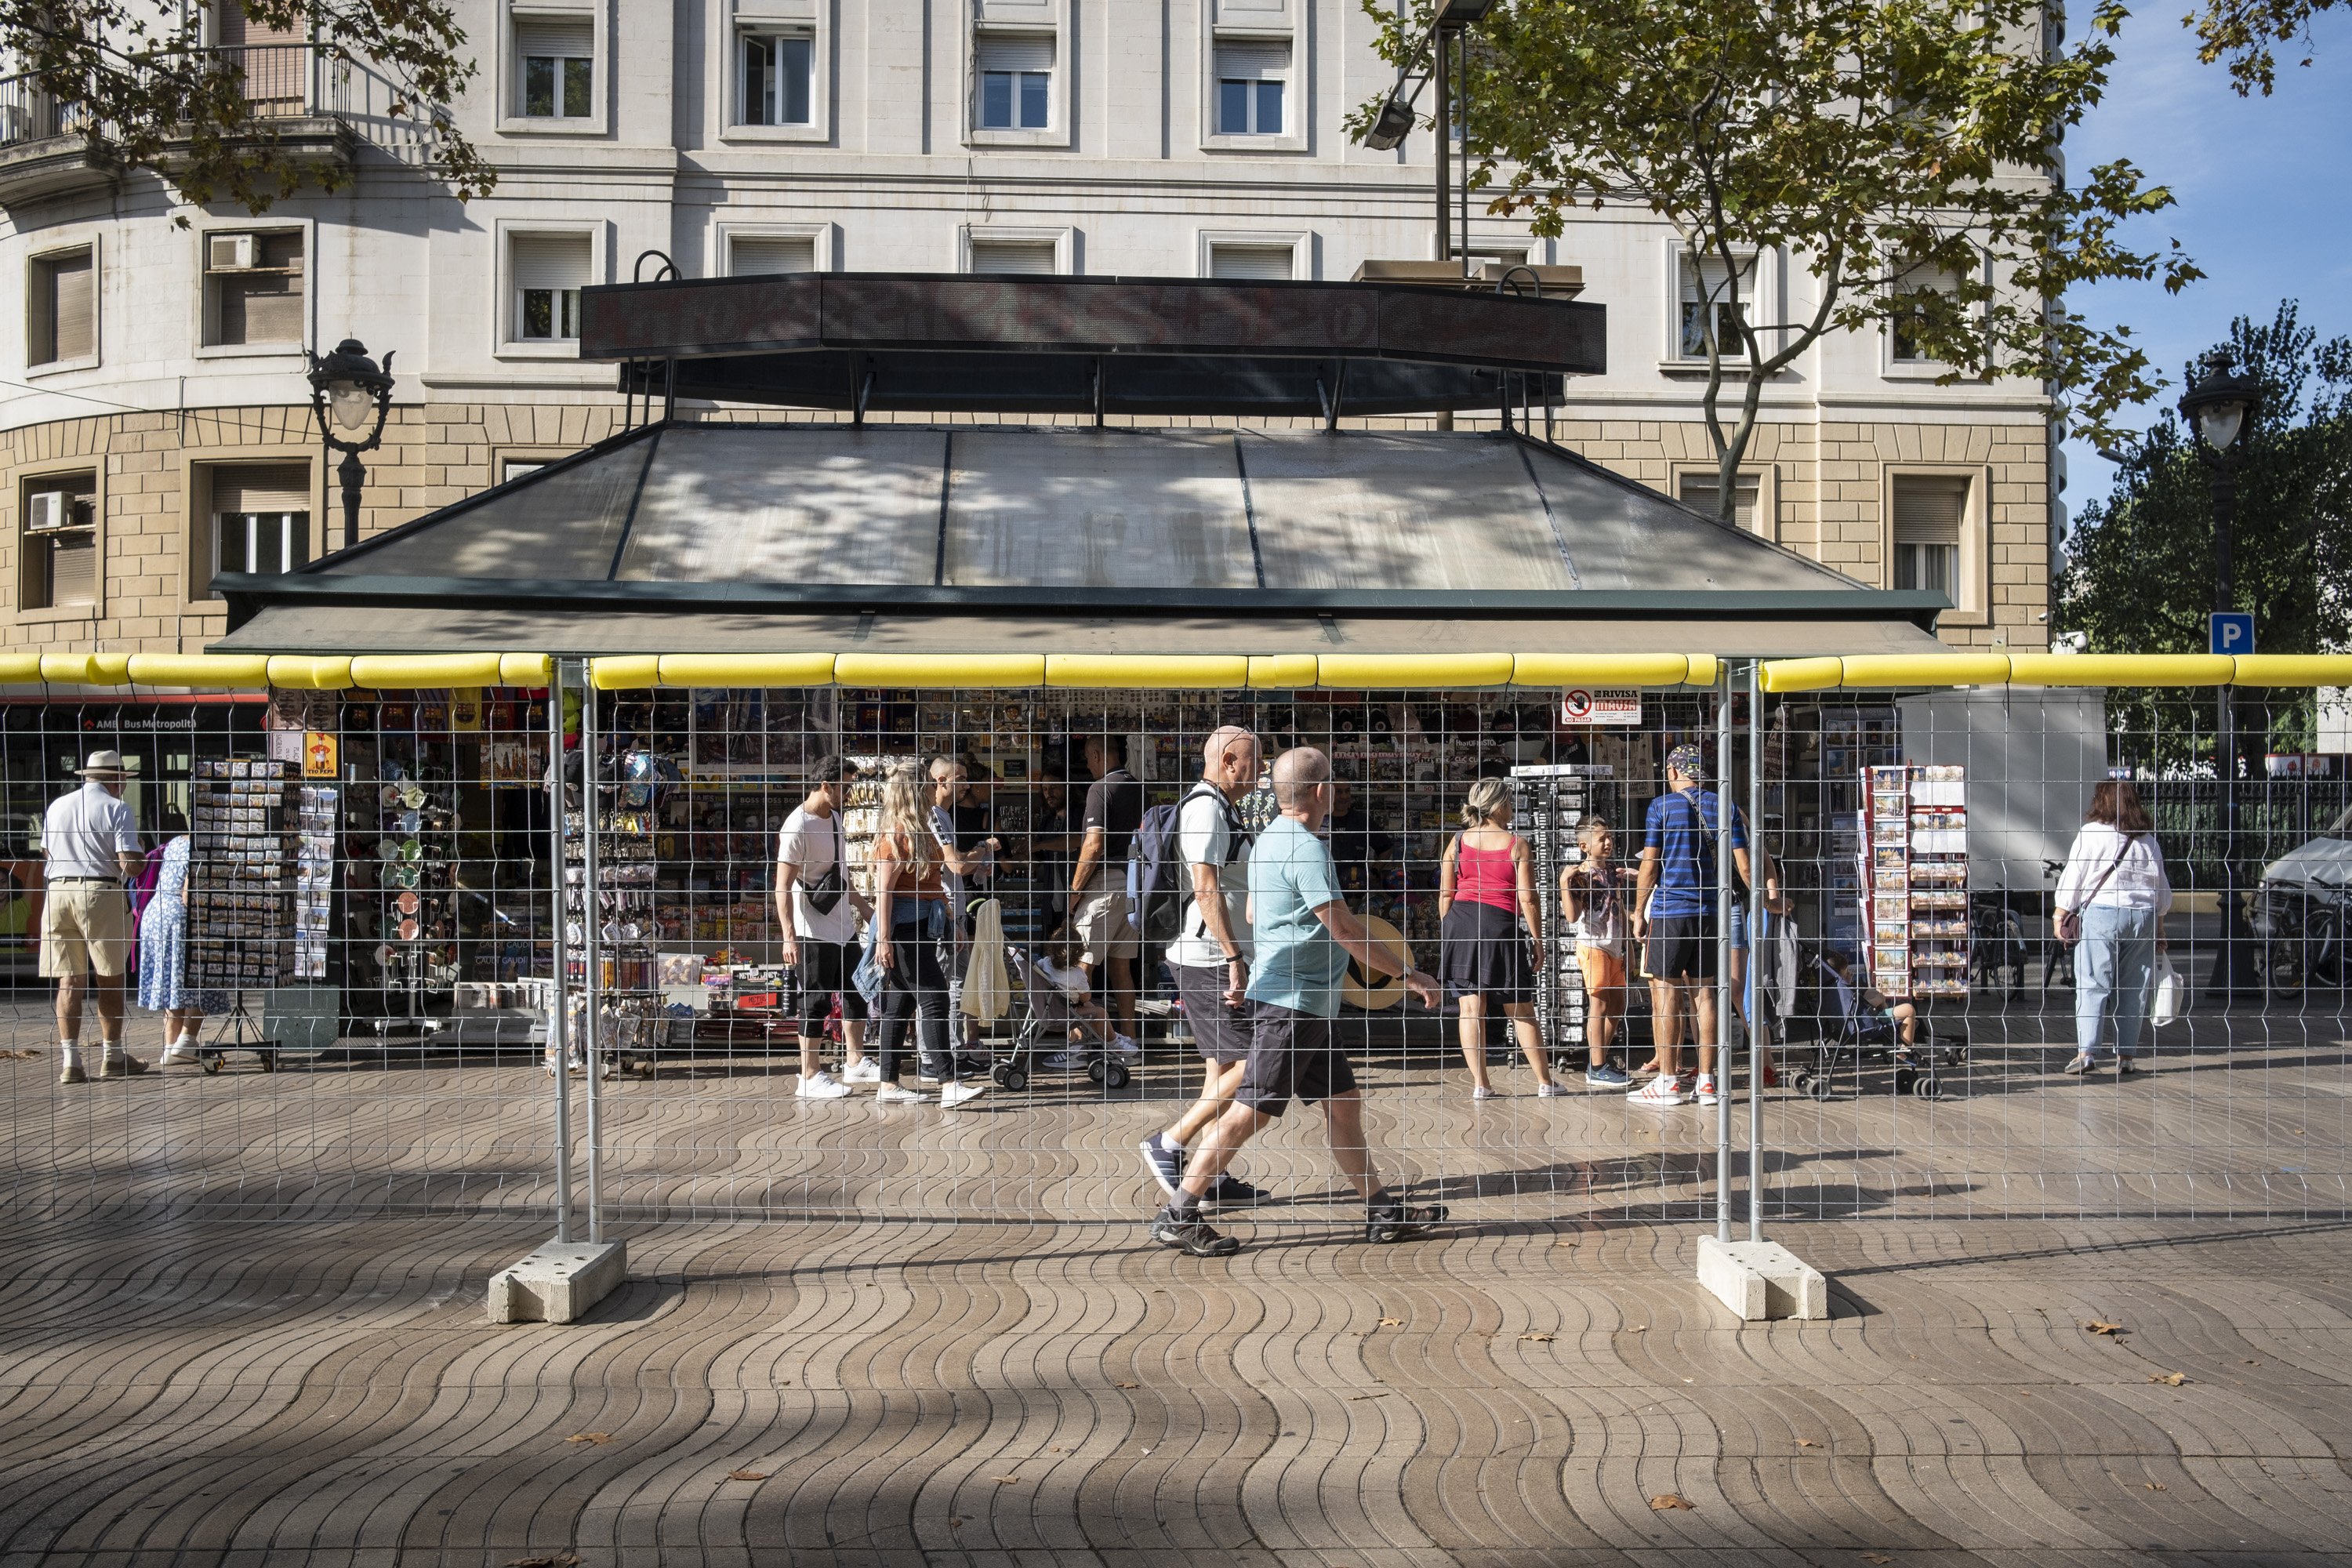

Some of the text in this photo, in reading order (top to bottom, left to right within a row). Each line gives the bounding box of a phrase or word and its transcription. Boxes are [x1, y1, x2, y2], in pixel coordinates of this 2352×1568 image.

[2223, 622, 2241, 648] P
[1595, 699, 1636, 710] MAUSA
[124, 719, 141, 729] Bus
